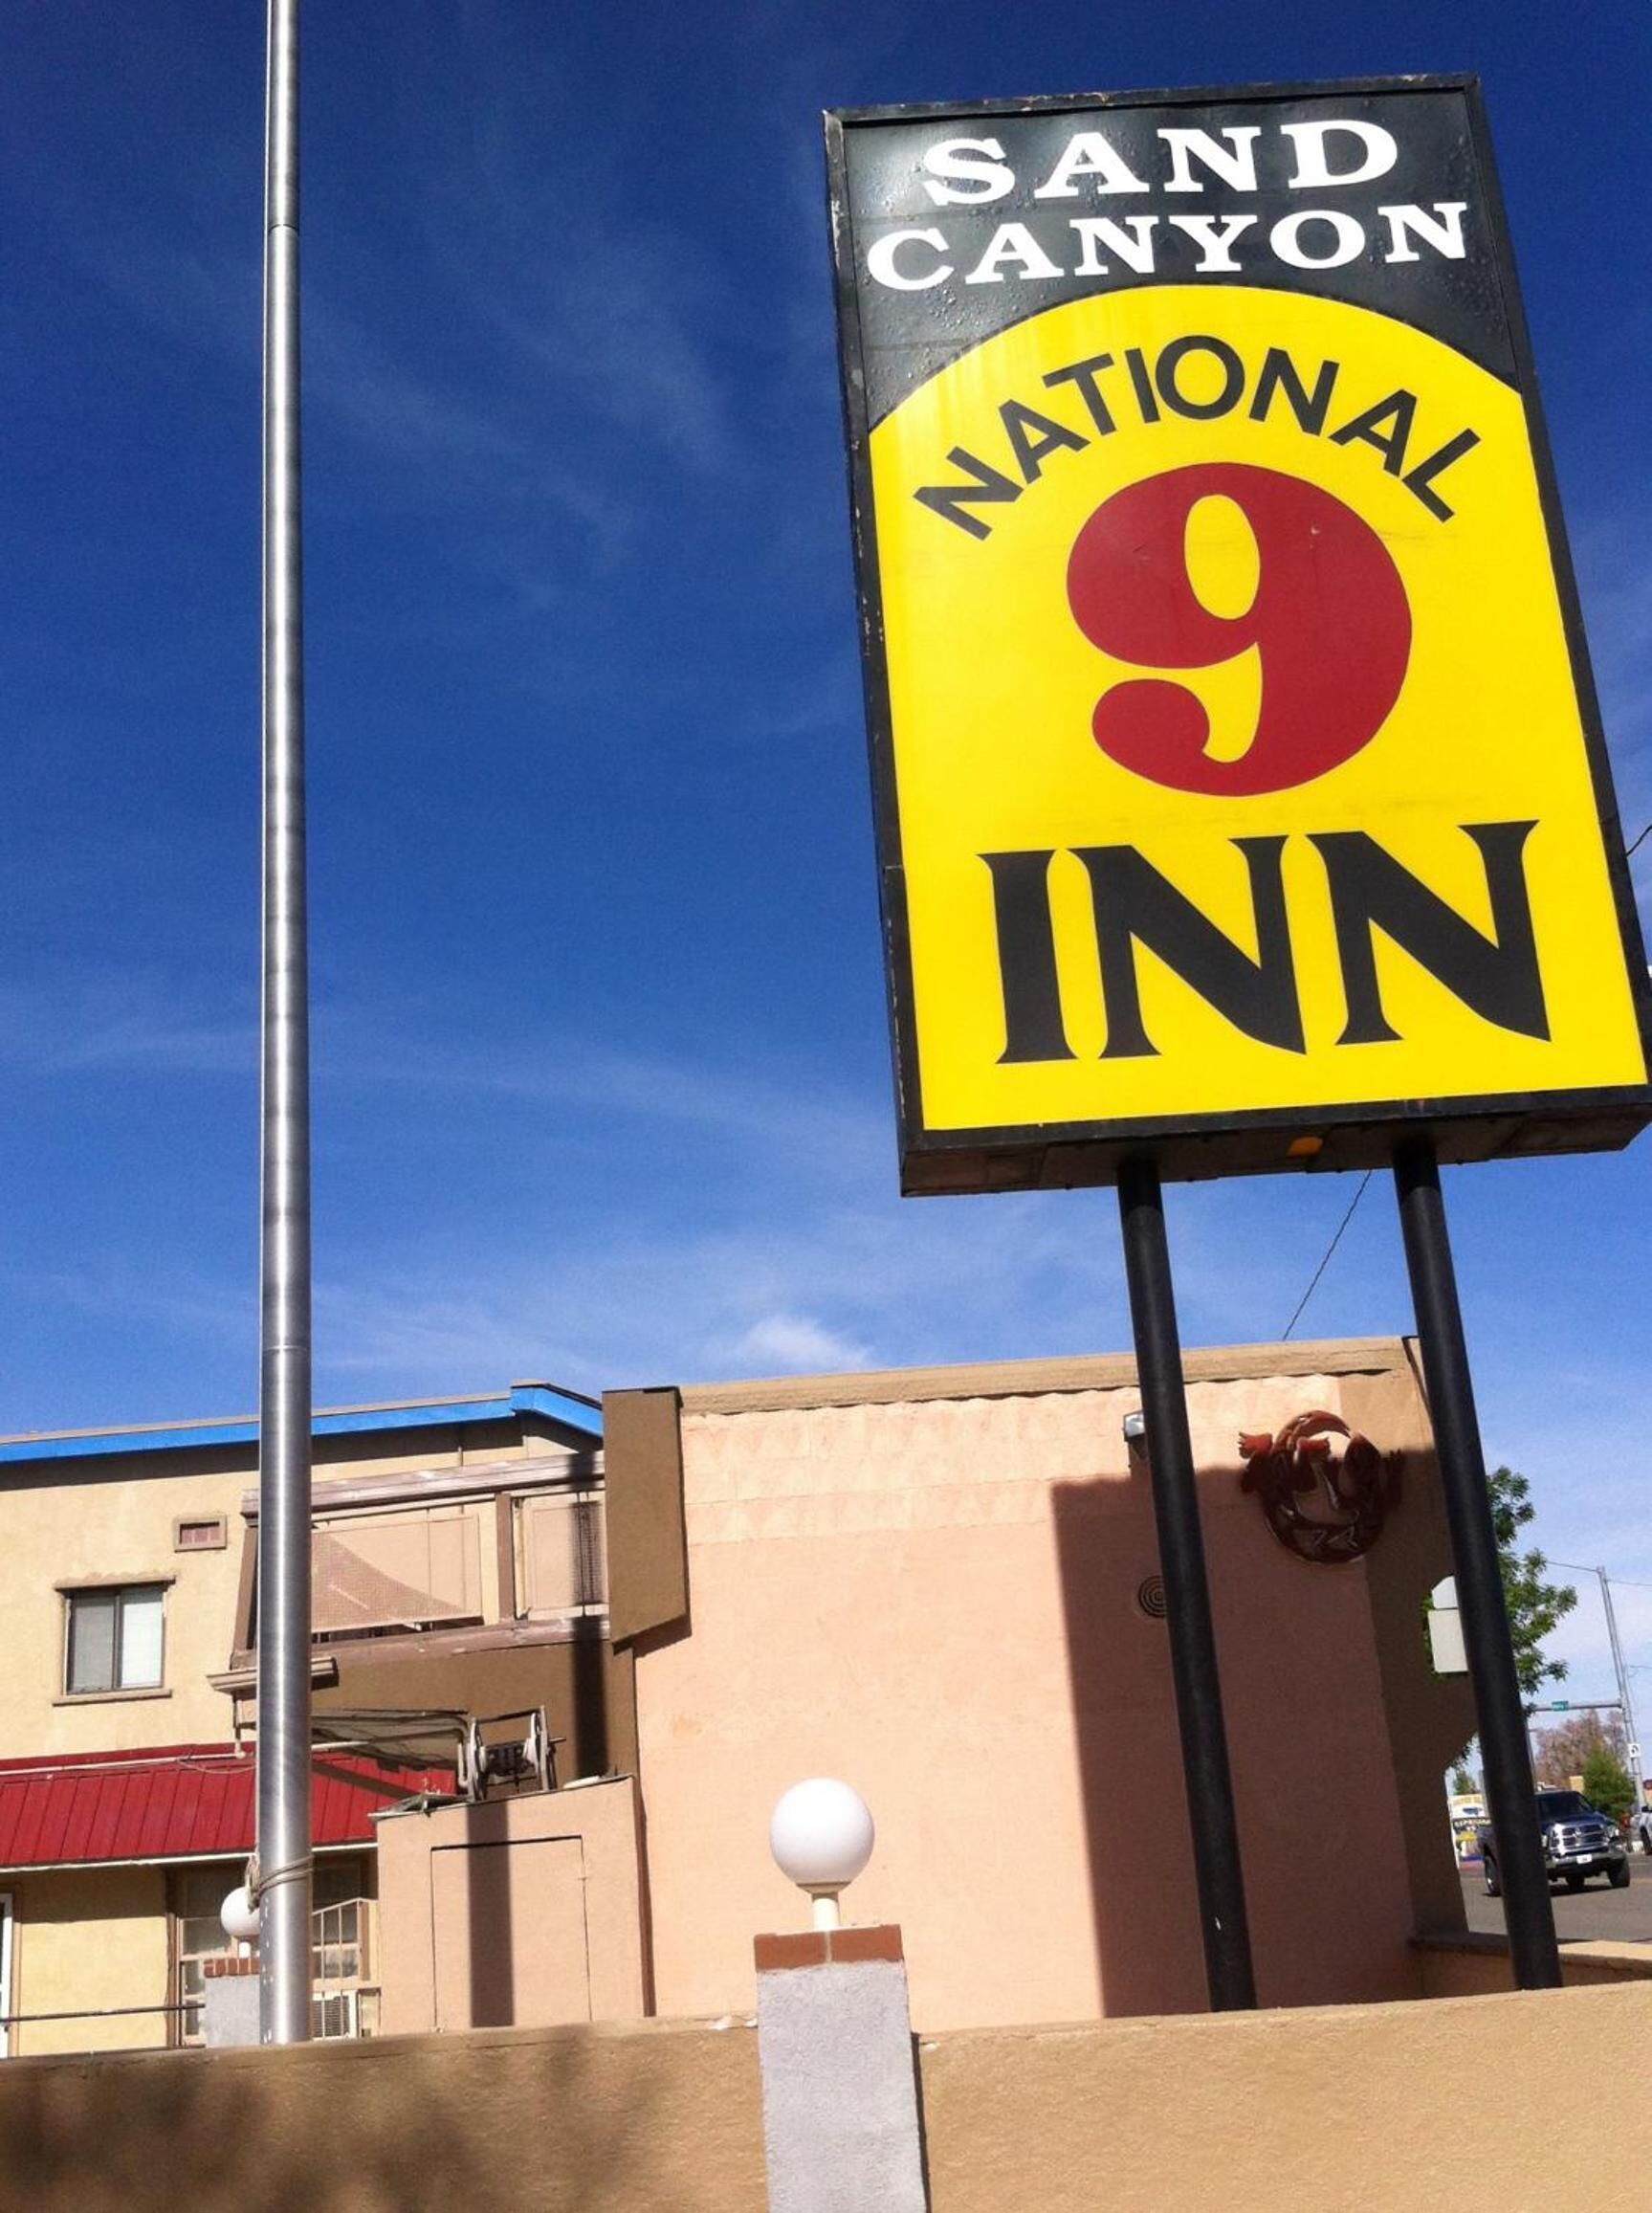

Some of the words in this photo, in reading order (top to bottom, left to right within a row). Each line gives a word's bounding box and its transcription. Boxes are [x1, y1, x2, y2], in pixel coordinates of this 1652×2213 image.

[867, 201, 1469, 291] CANYON
[921, 119, 1399, 209] SAND
[912, 334, 1482, 542] NATIONAL
[1067, 462, 1412, 797] 9
[976, 820, 1551, 1064] INN
